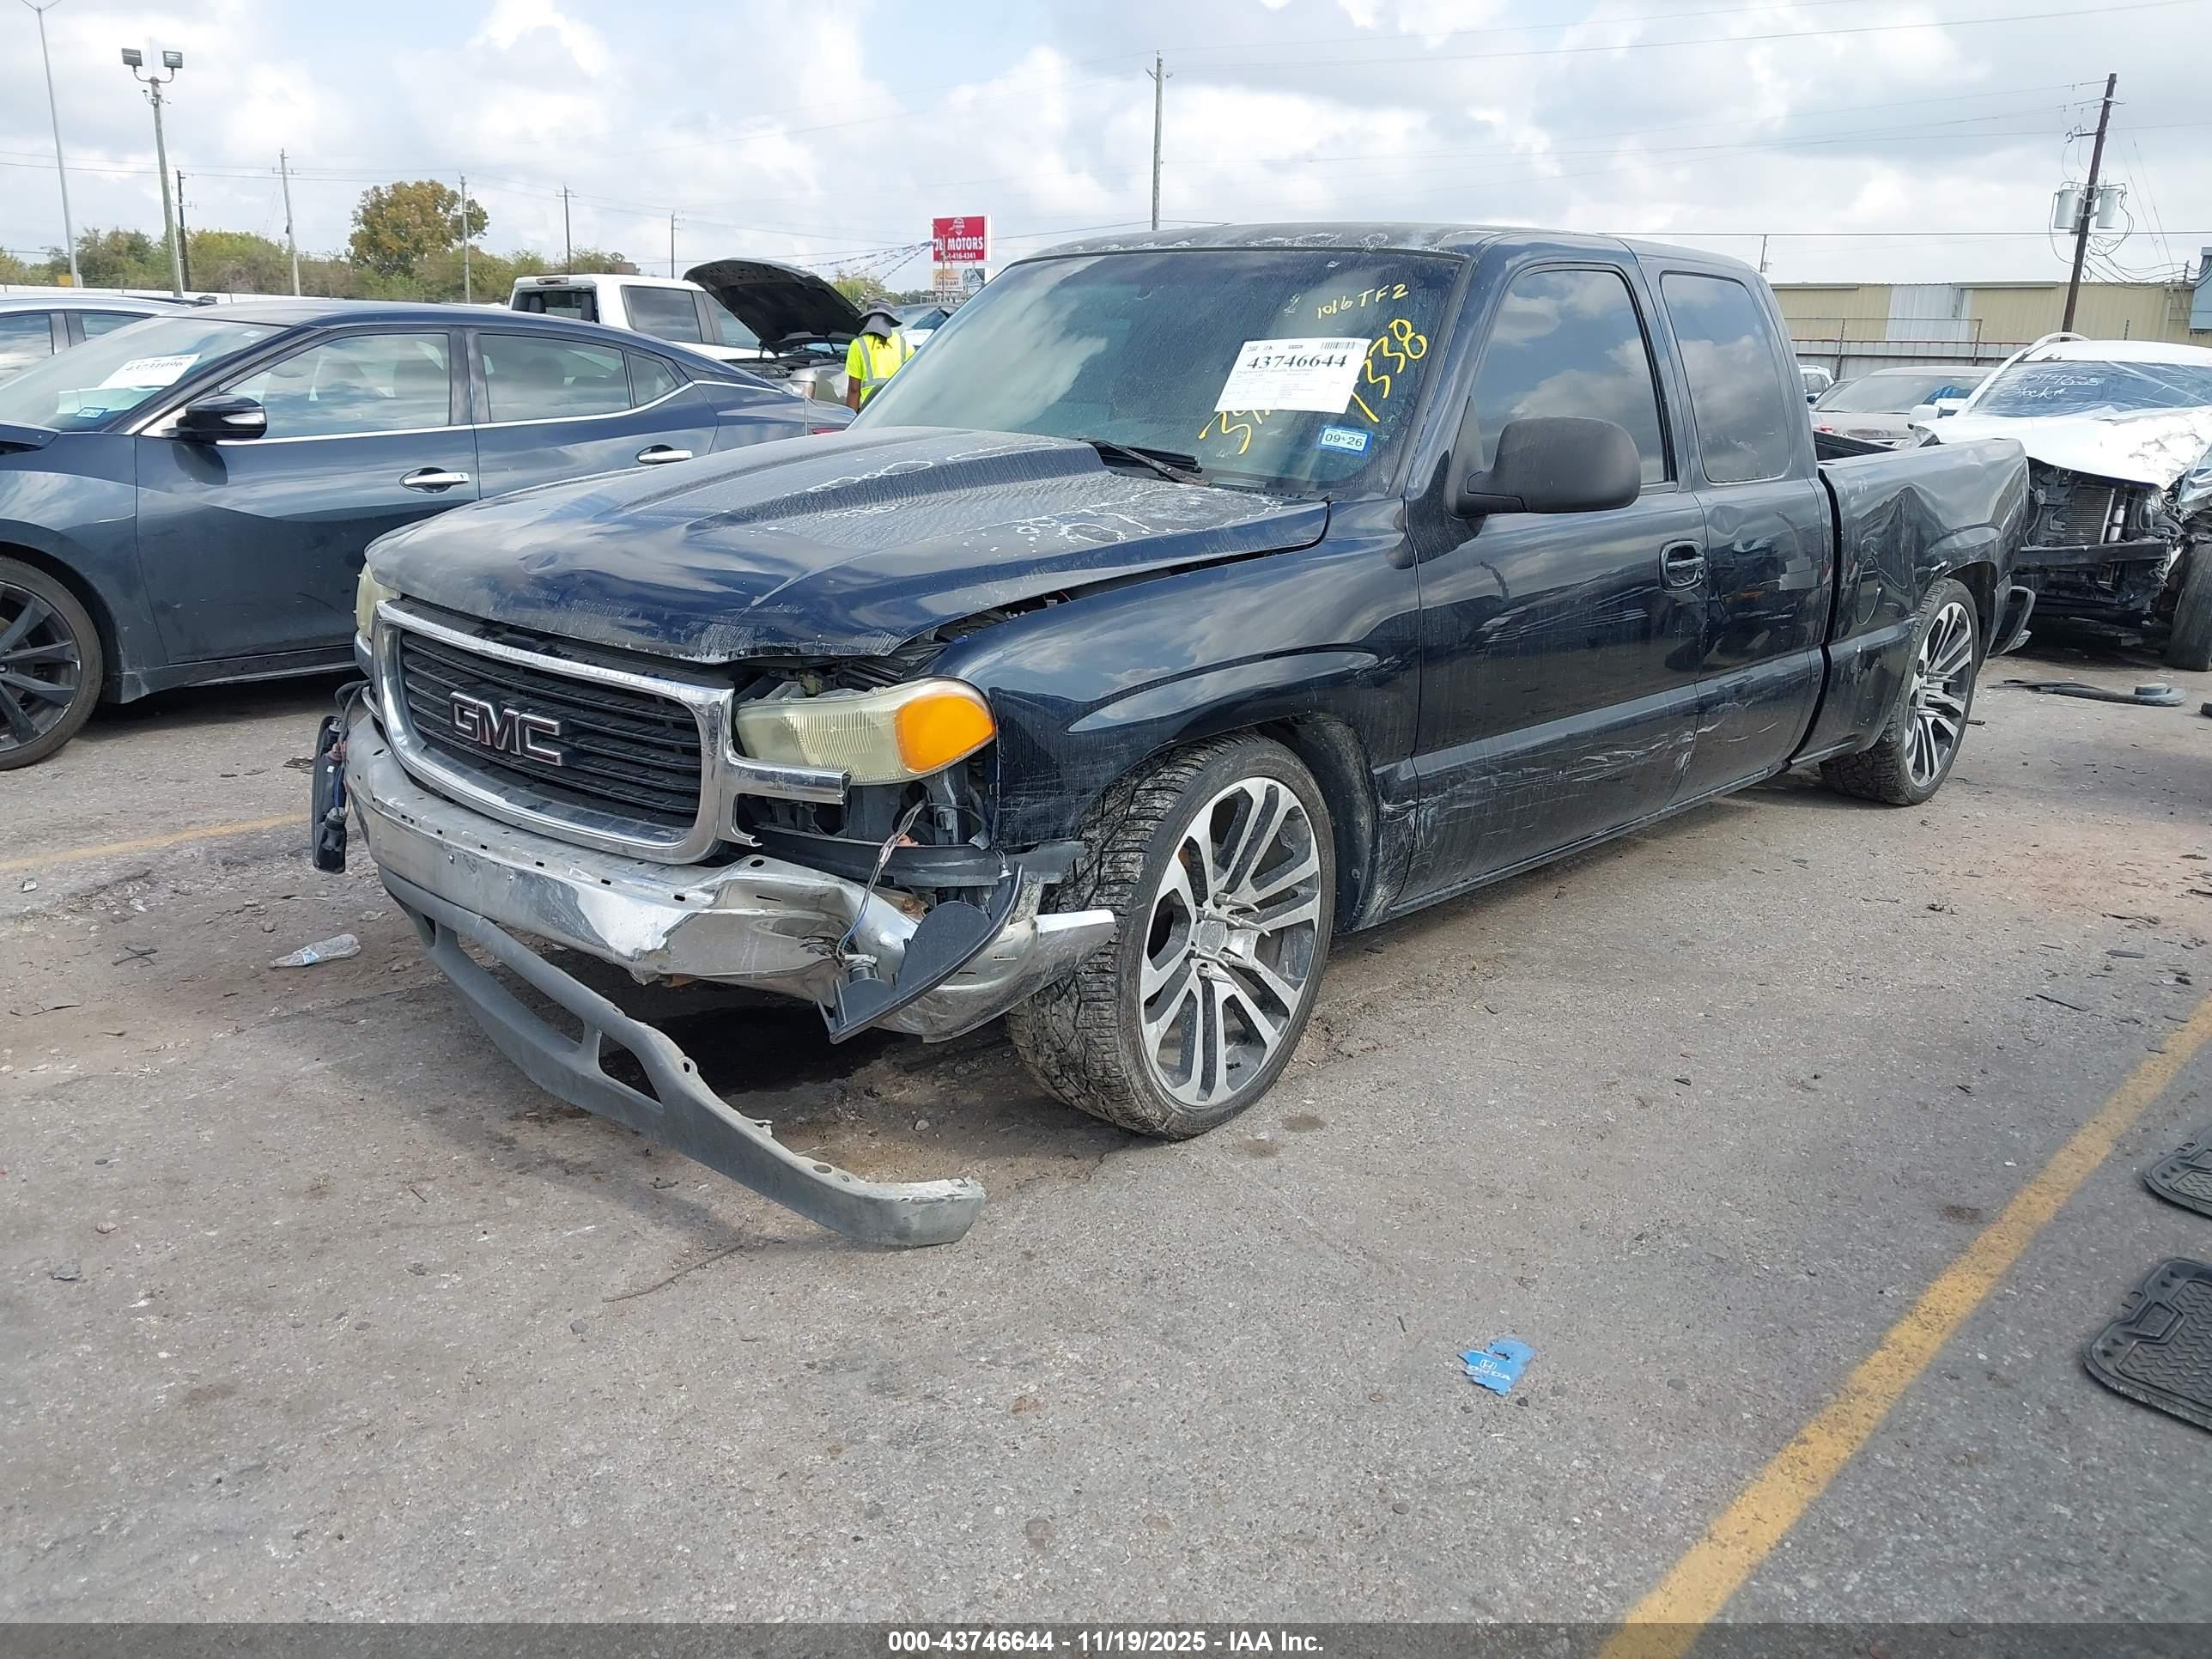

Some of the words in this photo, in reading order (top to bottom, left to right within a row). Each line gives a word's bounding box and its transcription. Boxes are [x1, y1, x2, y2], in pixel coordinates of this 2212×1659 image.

[947, 236, 983, 251] MOTORS
[1246, 354, 1348, 369] 43746644
[1325, 433, 1341, 443] 09
[1346, 436, 1364, 447] 26
[449, 690, 562, 767] GMC
